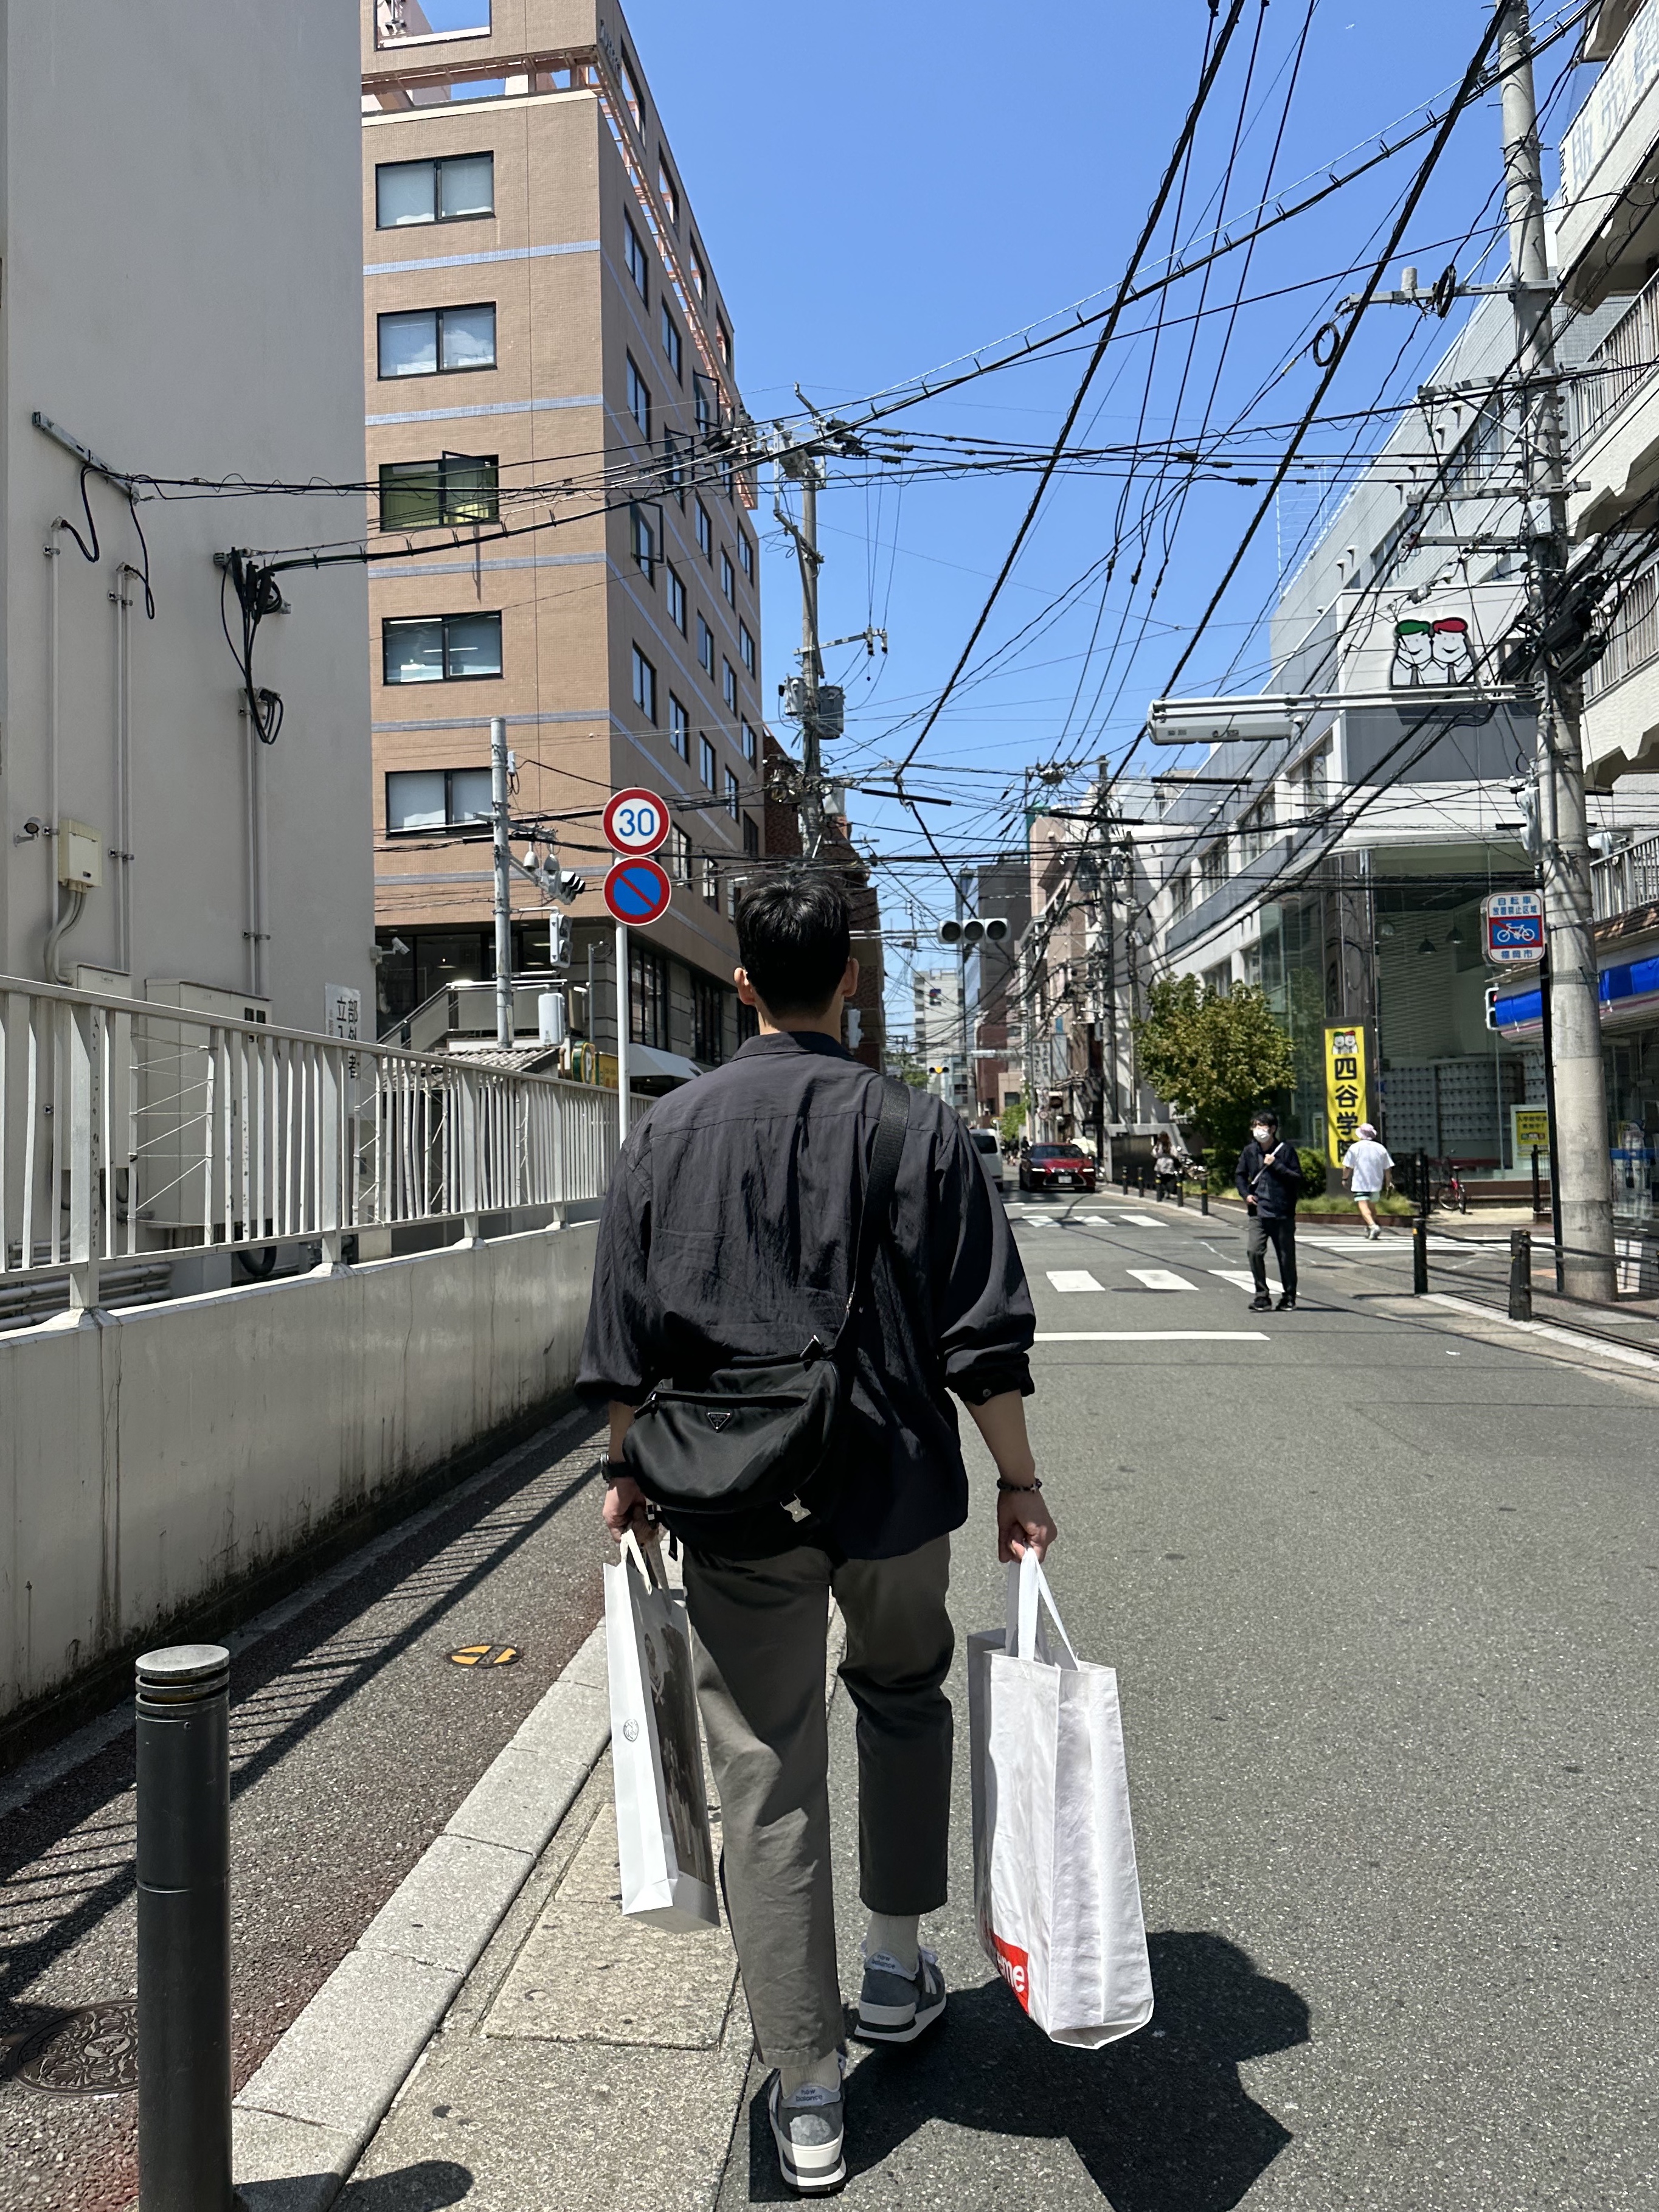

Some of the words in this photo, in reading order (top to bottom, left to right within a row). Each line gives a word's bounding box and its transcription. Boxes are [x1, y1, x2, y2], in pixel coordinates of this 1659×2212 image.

[619, 808, 654, 837] 30
[1498, 896, 1531, 906] 自転車
[1501, 949, 1533, 959] 福岡市
[586, 1052, 592, 1081] P
[871, 1958, 895, 1969] balance
